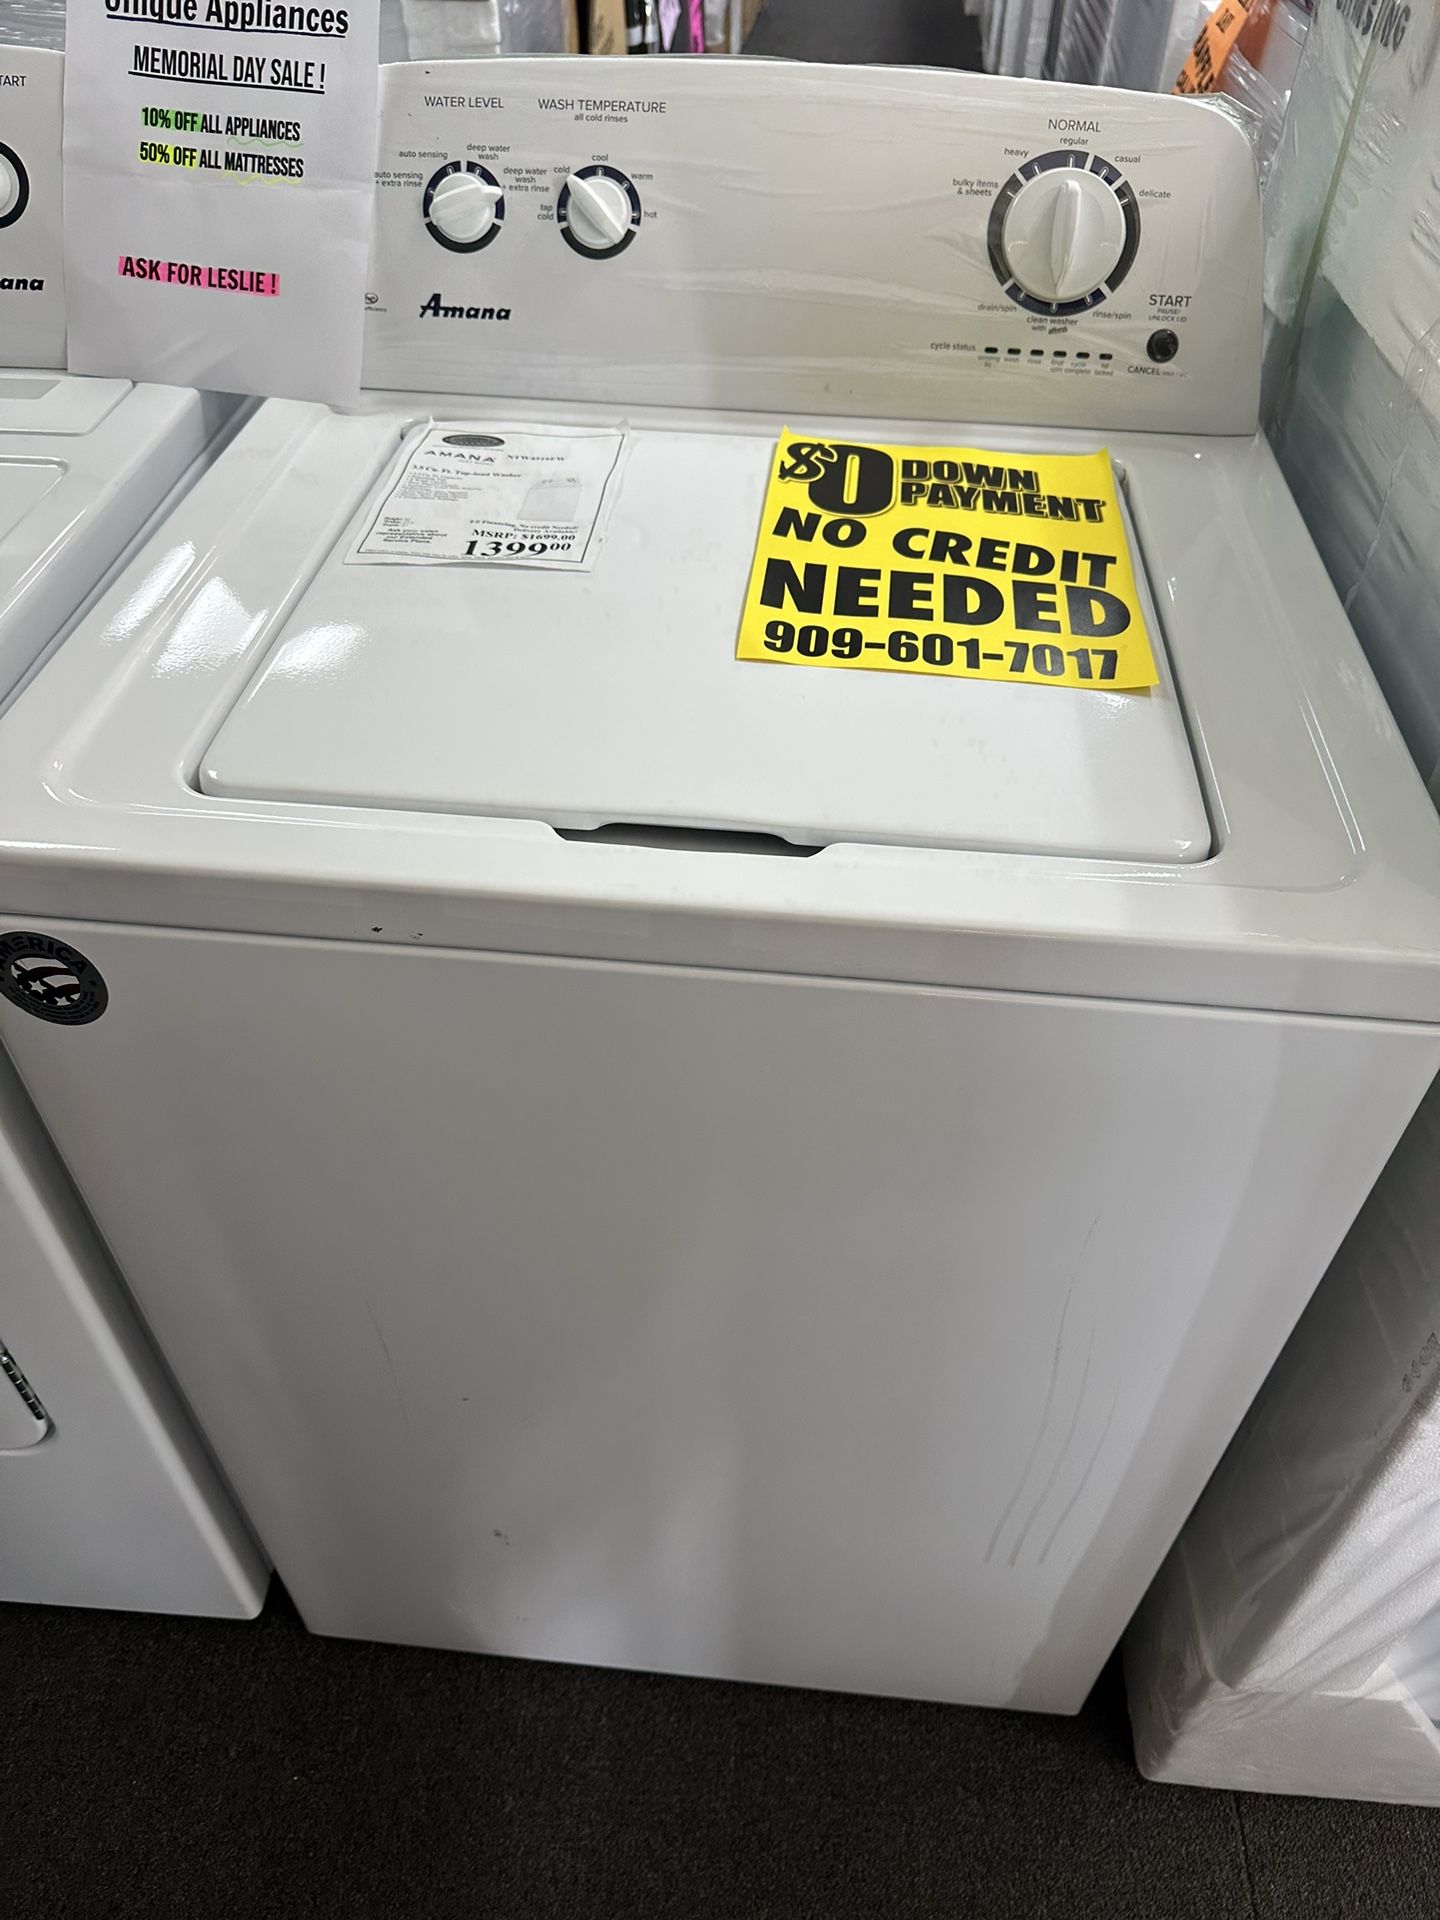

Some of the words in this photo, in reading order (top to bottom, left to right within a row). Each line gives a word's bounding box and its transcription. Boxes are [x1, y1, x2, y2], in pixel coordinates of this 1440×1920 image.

[205, 0, 349, 34] Appliances
[134, 45, 228, 81] MEMORIAL
[233, 56, 266, 83] DAY
[271, 58, 315, 88] SALE
[424, 96, 465, 108] WATER
[468, 97, 504, 109] LEVEL
[538, 98, 574, 110] WASH
[578, 100, 667, 113] TEMPERATURE
[142, 107, 171, 129] 10%
[174, 111, 198, 132] OFF
[200, 114, 222, 134] ALL
[225, 116, 301, 141] APPLIANCES
[585, 114, 603, 122] cold
[604, 114, 628, 123] rinses
[1048, 119, 1101, 133] NORMAL
[1059, 136, 1088, 146] regular
[466, 143, 487, 152] deep
[1004, 148, 1029, 158] heavy
[140, 142, 170, 163] 50%
[173, 146, 197, 166] OFF
[199, 149, 222, 169] ALL
[225, 152, 304, 177] MATTRESSES
[418, 151, 448, 160] sensing
[478, 153, 499, 161] wash
[1115, 154, 1141, 164] casual
[503, 167, 523, 176] deep
[525, 168, 548, 176] water
[553, 166, 571, 174] cold
[374, 171, 391, 179] auto
[393, 171, 423, 181] sensing
[515, 176, 536, 184] wash
[402, 180, 423, 188] rinse
[952, 178, 975, 189] bulky
[976, 180, 999, 189] items
[964, 188, 992, 197] sheets
[1139, 189, 1171, 198] delicate
[540, 203, 553, 212] tap
[123, 256, 161, 281] ASK
[167, 262, 202, 286] FOR
[208, 267, 266, 293] LESLIE
[1149, 294, 1192, 307] START
[419, 293, 512, 320] Amana
[977, 303, 1017, 313] drain/spin
[1092, 310, 1132, 321] rinse/spin
[1026, 316, 1048, 324] clean
[1050, 317, 1078, 327] washer
[930, 342, 951, 351] cycle
[952, 343, 976, 352] status
[1128, 365, 1160, 376] CANCEL
[424, 450, 496, 463] AMANA
[779, 442, 896, 516] $0
[901, 459, 1040, 492] DOWN
[901, 482, 1105, 523] PAYMENT
[472, 529, 517, 540] MSRP:
[521, 533, 576, 541] $1699.00
[772, 506, 867, 548] NO
[892, 527, 1117, 589] CREDIT
[760, 558, 1131, 638] NEEDED
[763, 620, 1118, 680] 909-601-7017
